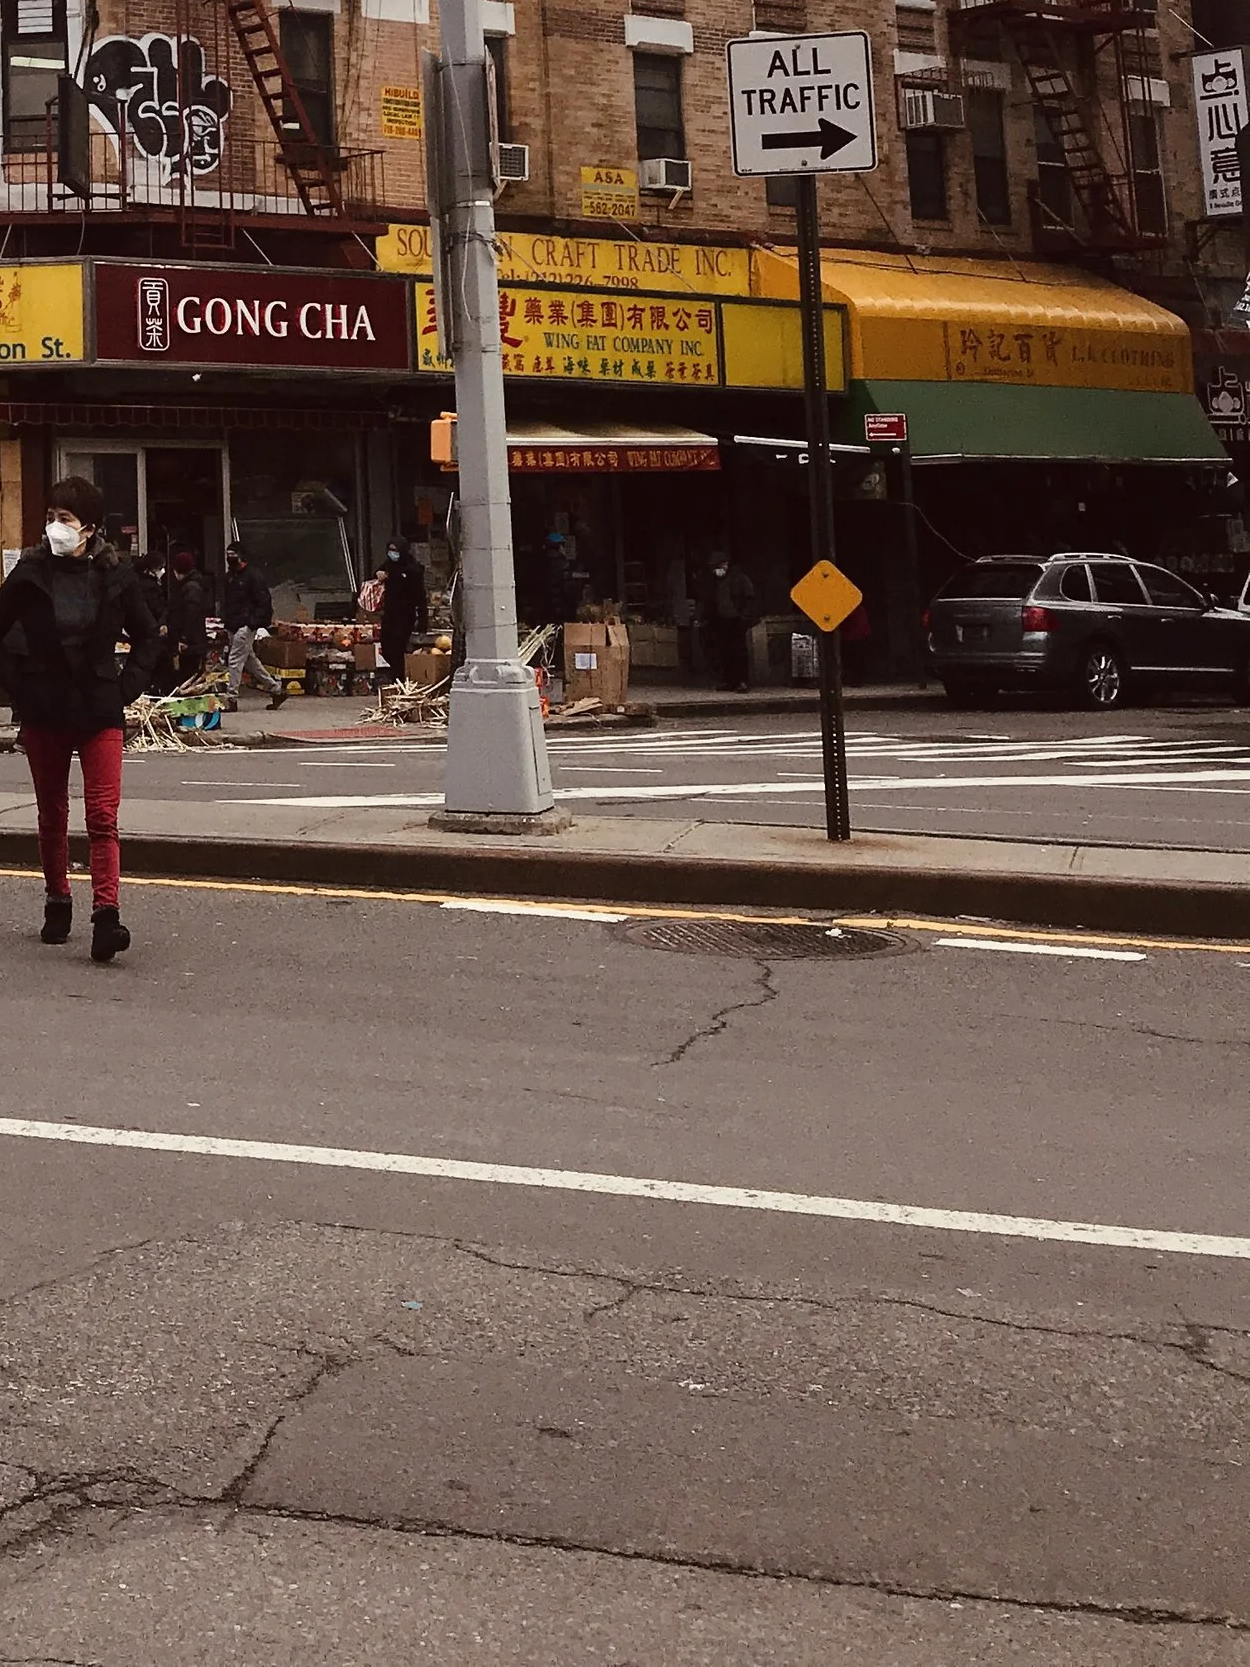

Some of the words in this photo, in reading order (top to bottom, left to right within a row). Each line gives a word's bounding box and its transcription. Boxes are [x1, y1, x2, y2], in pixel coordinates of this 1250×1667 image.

[766, 47, 832, 78] ALL
[741, 82, 861, 116] TRAFFIC
[593, 170, 625, 184] ASA
[531, 237, 600, 270] CRAFT
[613, 243, 682, 274] TRADE
[695, 248, 732, 277] INC.
[176, 296, 289, 338] GONG
[299, 302, 377, 342] CHA
[41, 336, 71, 359] St.
[543, 332, 580, 350] WING
[613, 336, 674, 355] COMPANY
